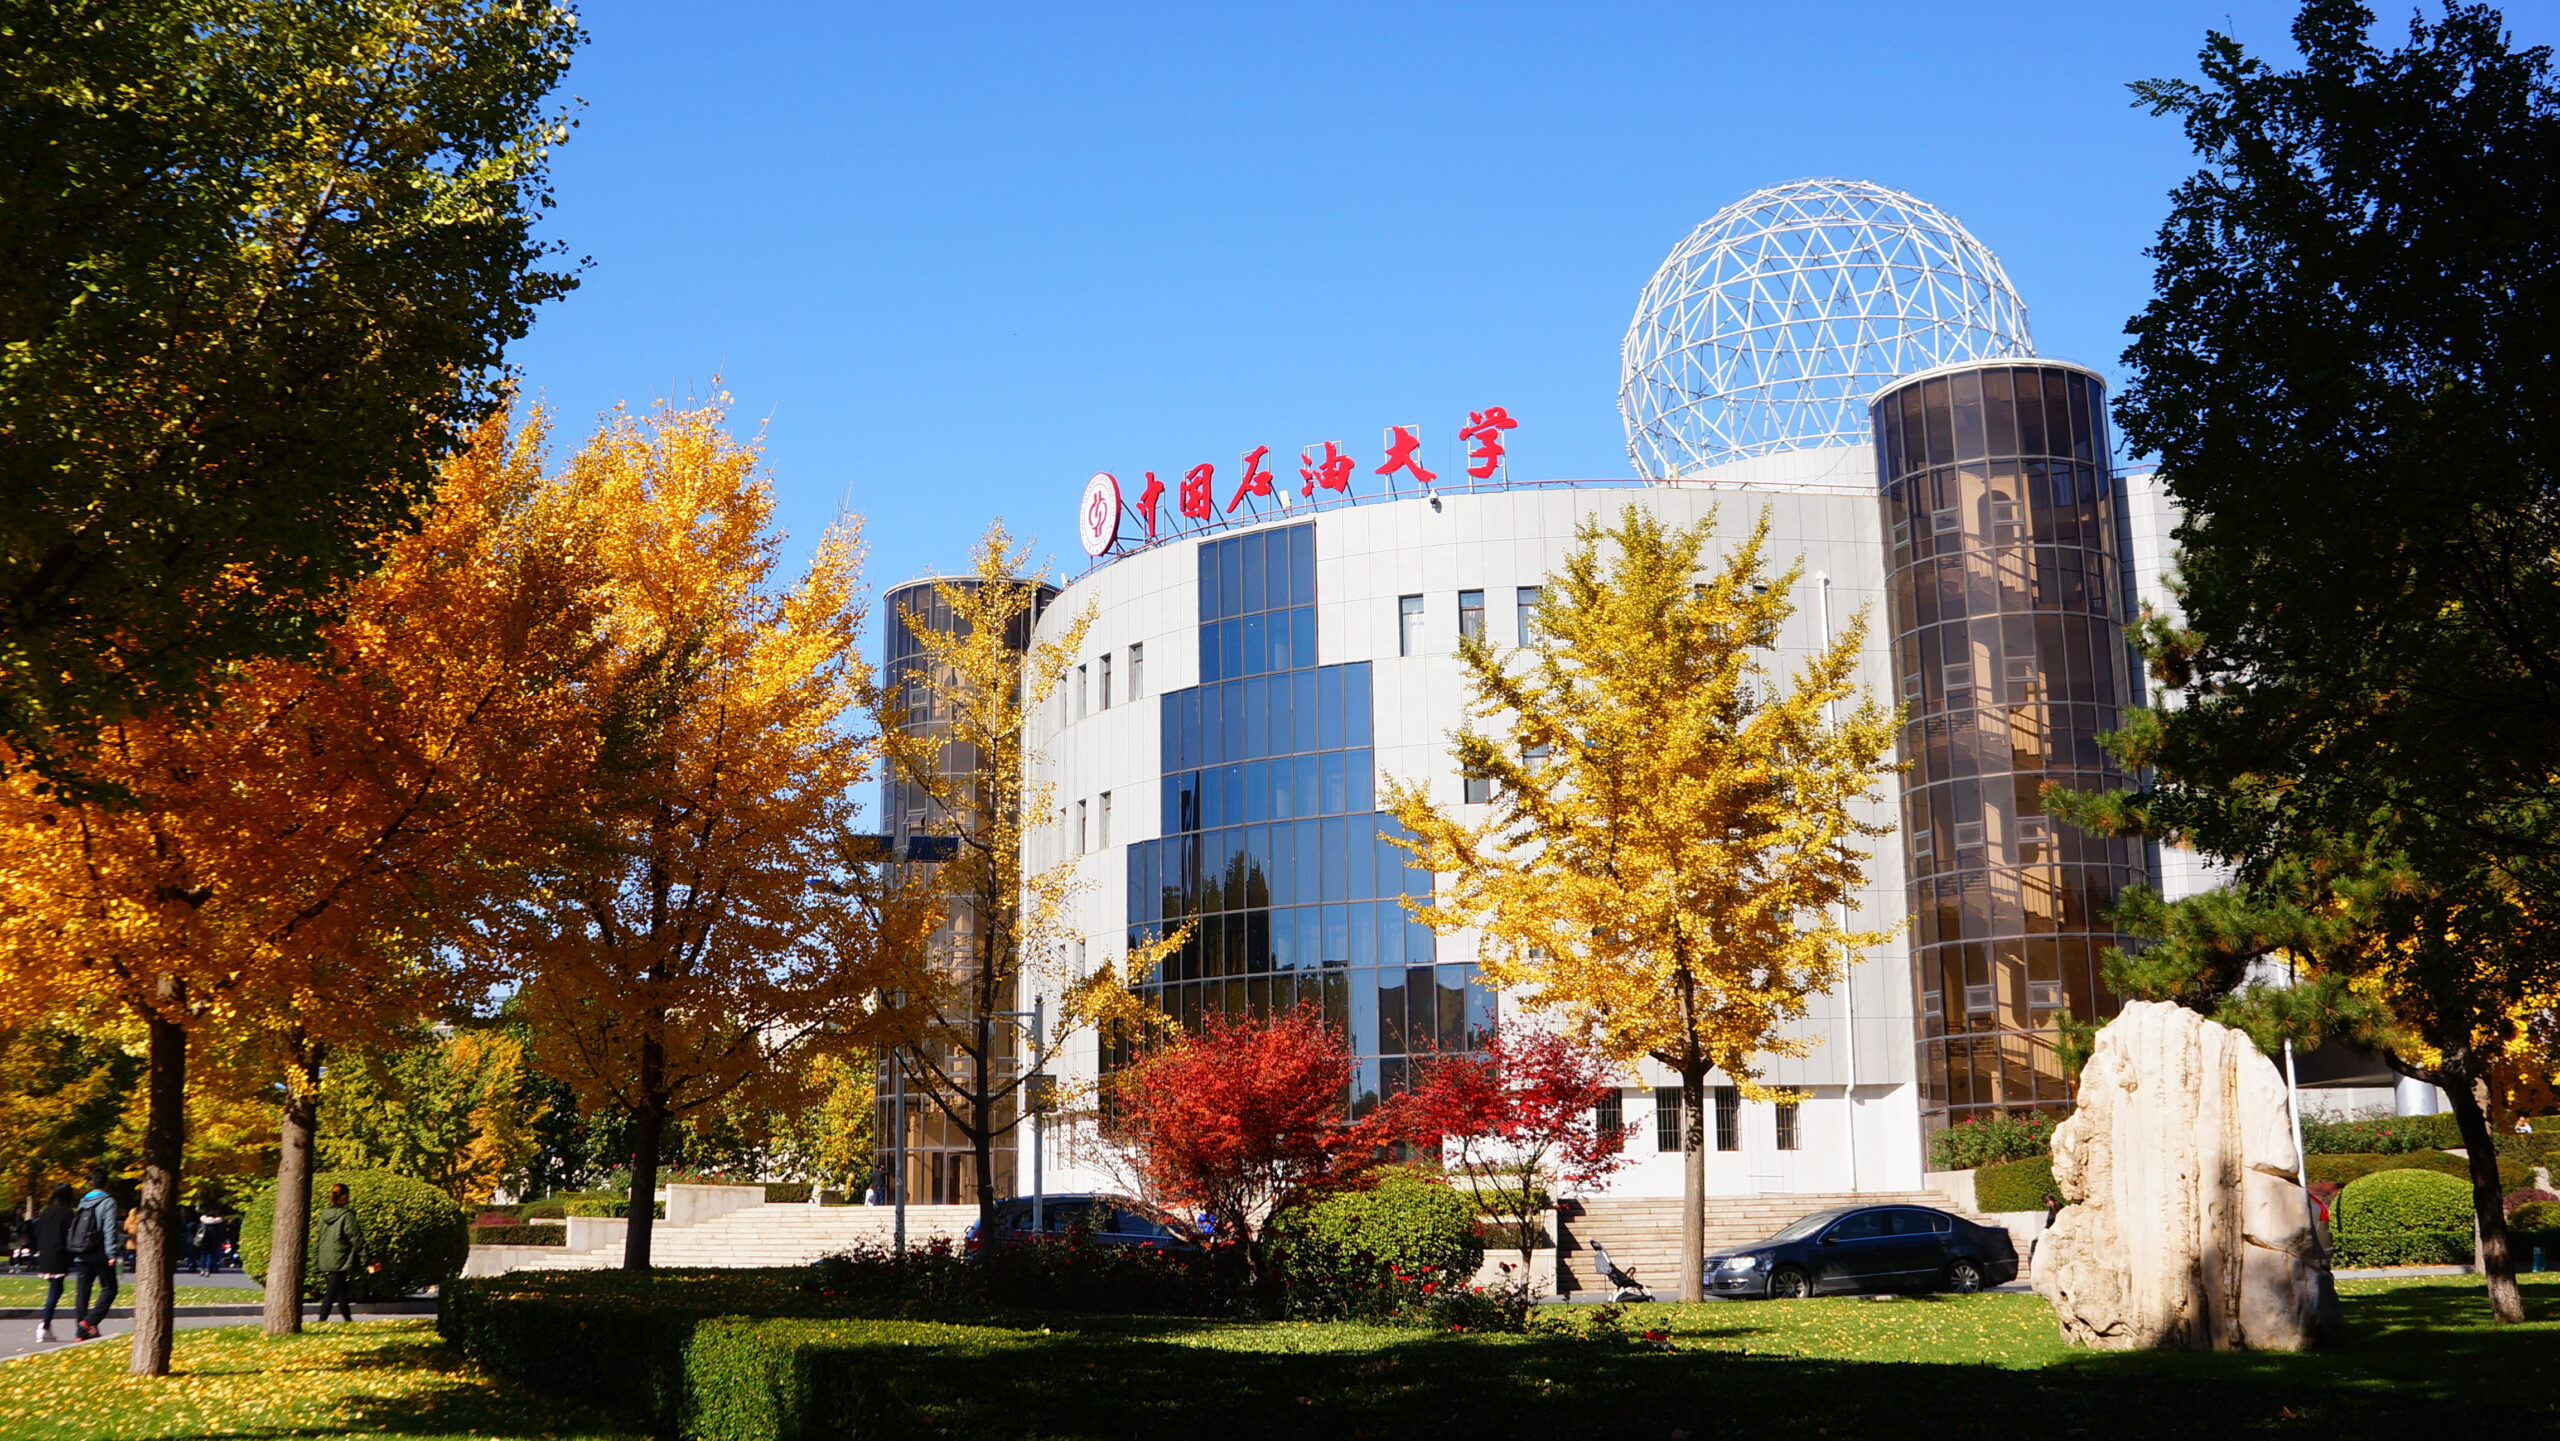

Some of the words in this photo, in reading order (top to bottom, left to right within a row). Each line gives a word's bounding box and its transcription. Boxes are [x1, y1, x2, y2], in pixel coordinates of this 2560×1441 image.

[1136, 406, 1518, 538] 中国石油大学
